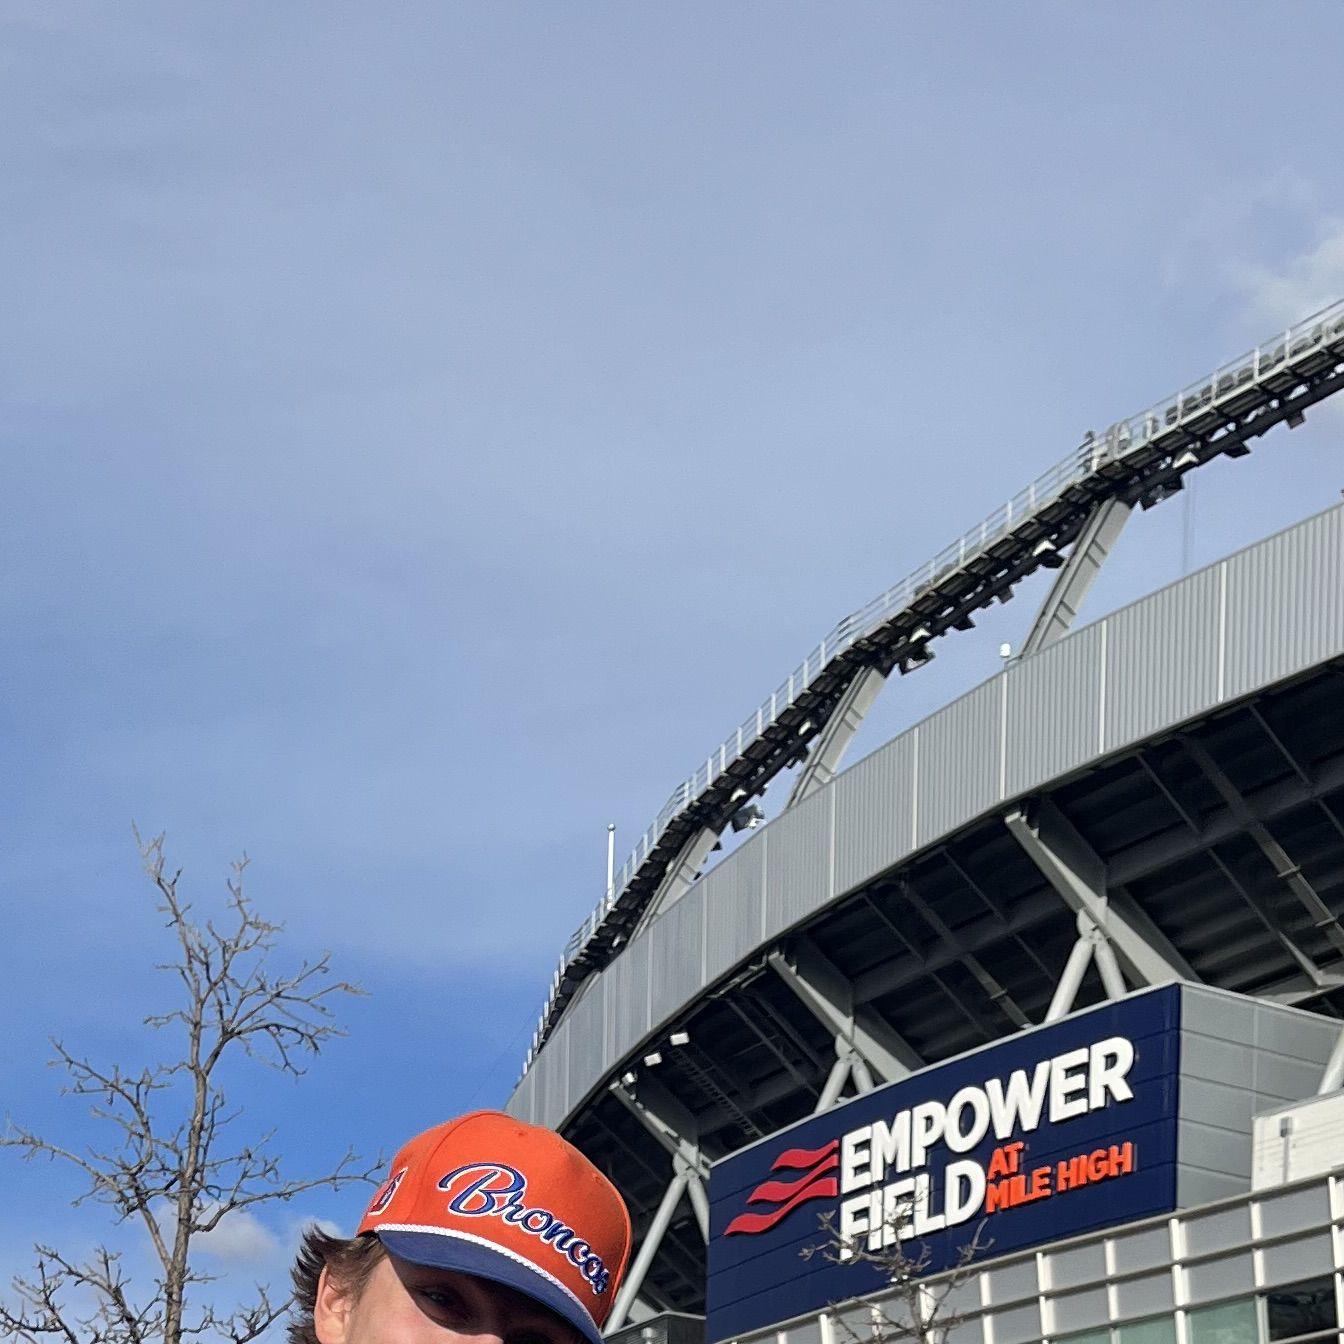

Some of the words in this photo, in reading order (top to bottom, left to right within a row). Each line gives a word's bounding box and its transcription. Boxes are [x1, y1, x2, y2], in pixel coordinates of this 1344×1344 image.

[842, 1037, 1135, 1194] EMPOWER
[986, 1141, 1024, 1180] AT
[986, 1167, 1052, 1213] MILE
[1057, 1141, 1133, 1190] HIGH
[839, 1160, 986, 1261] FIELD
